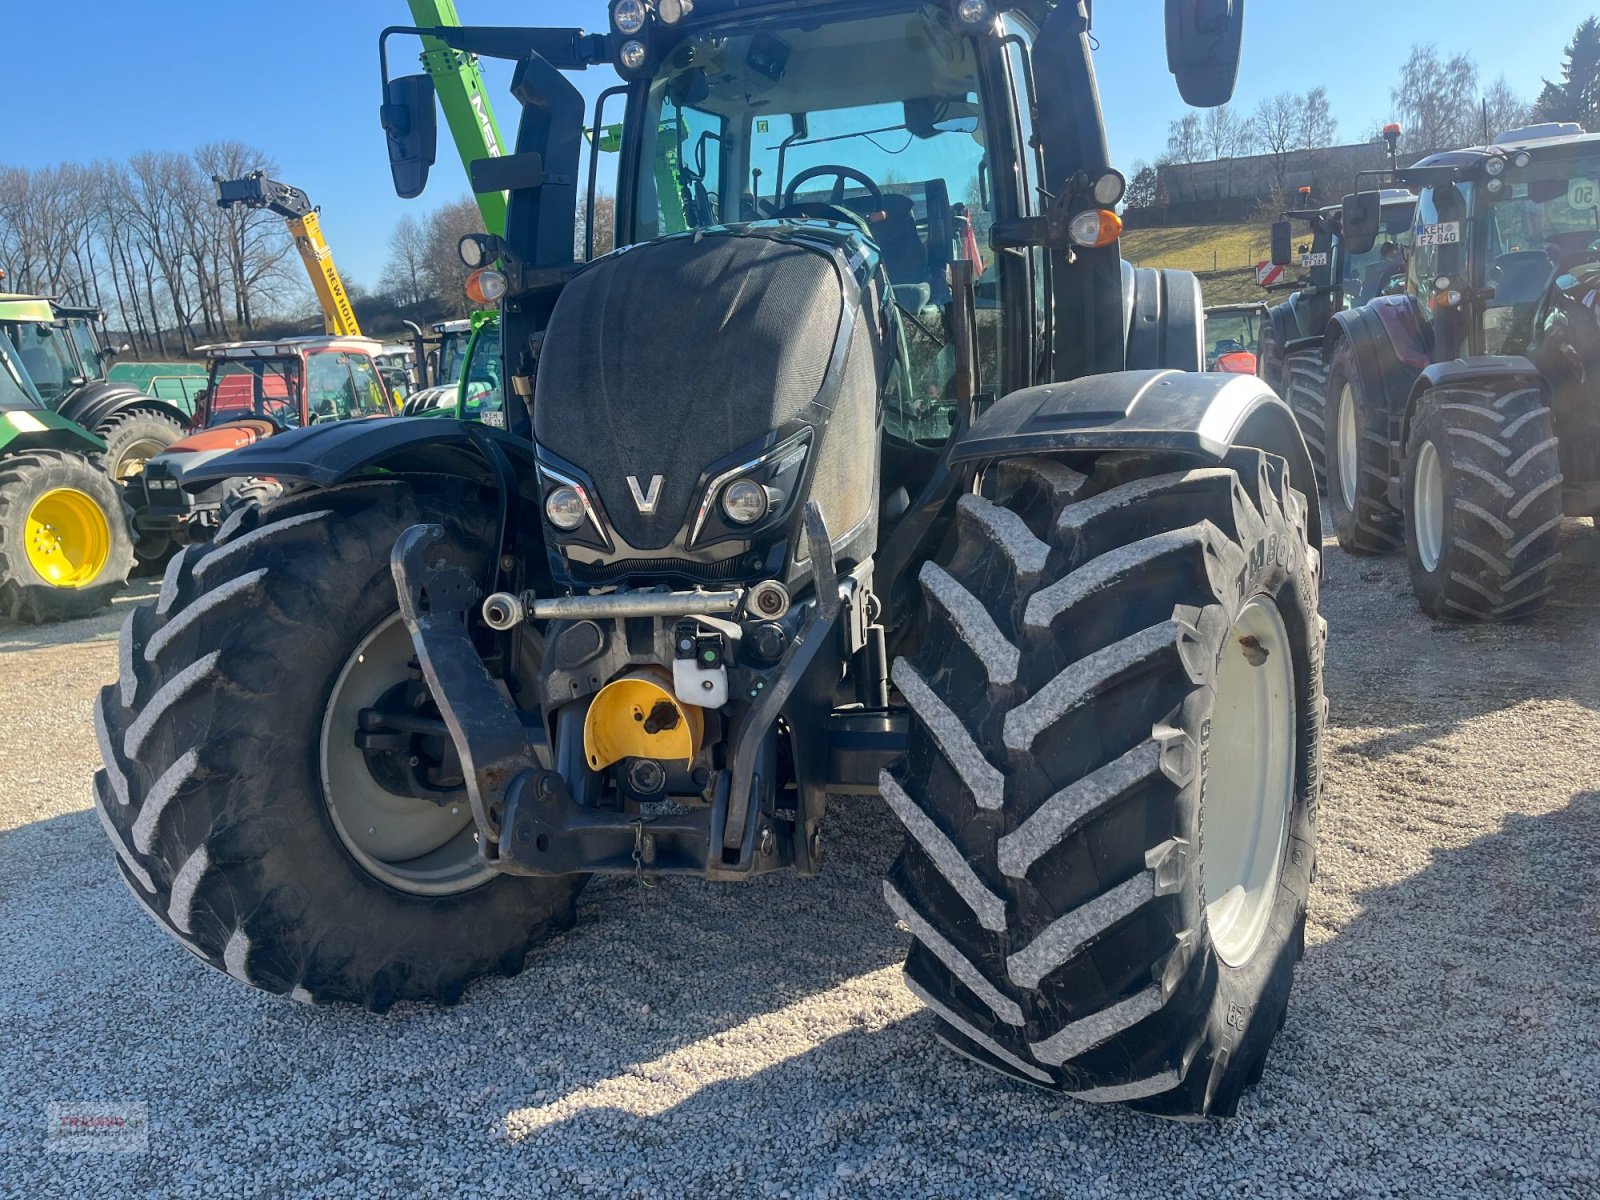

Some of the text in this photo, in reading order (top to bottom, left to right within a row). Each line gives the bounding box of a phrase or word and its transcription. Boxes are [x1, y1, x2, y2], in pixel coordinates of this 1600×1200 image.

[1420, 233, 1456, 246] FZ 840
[1424, 224, 1444, 235] KEH
[327, 267, 358, 336] NEW HOLLA
[1234, 532, 1298, 603] TM800
